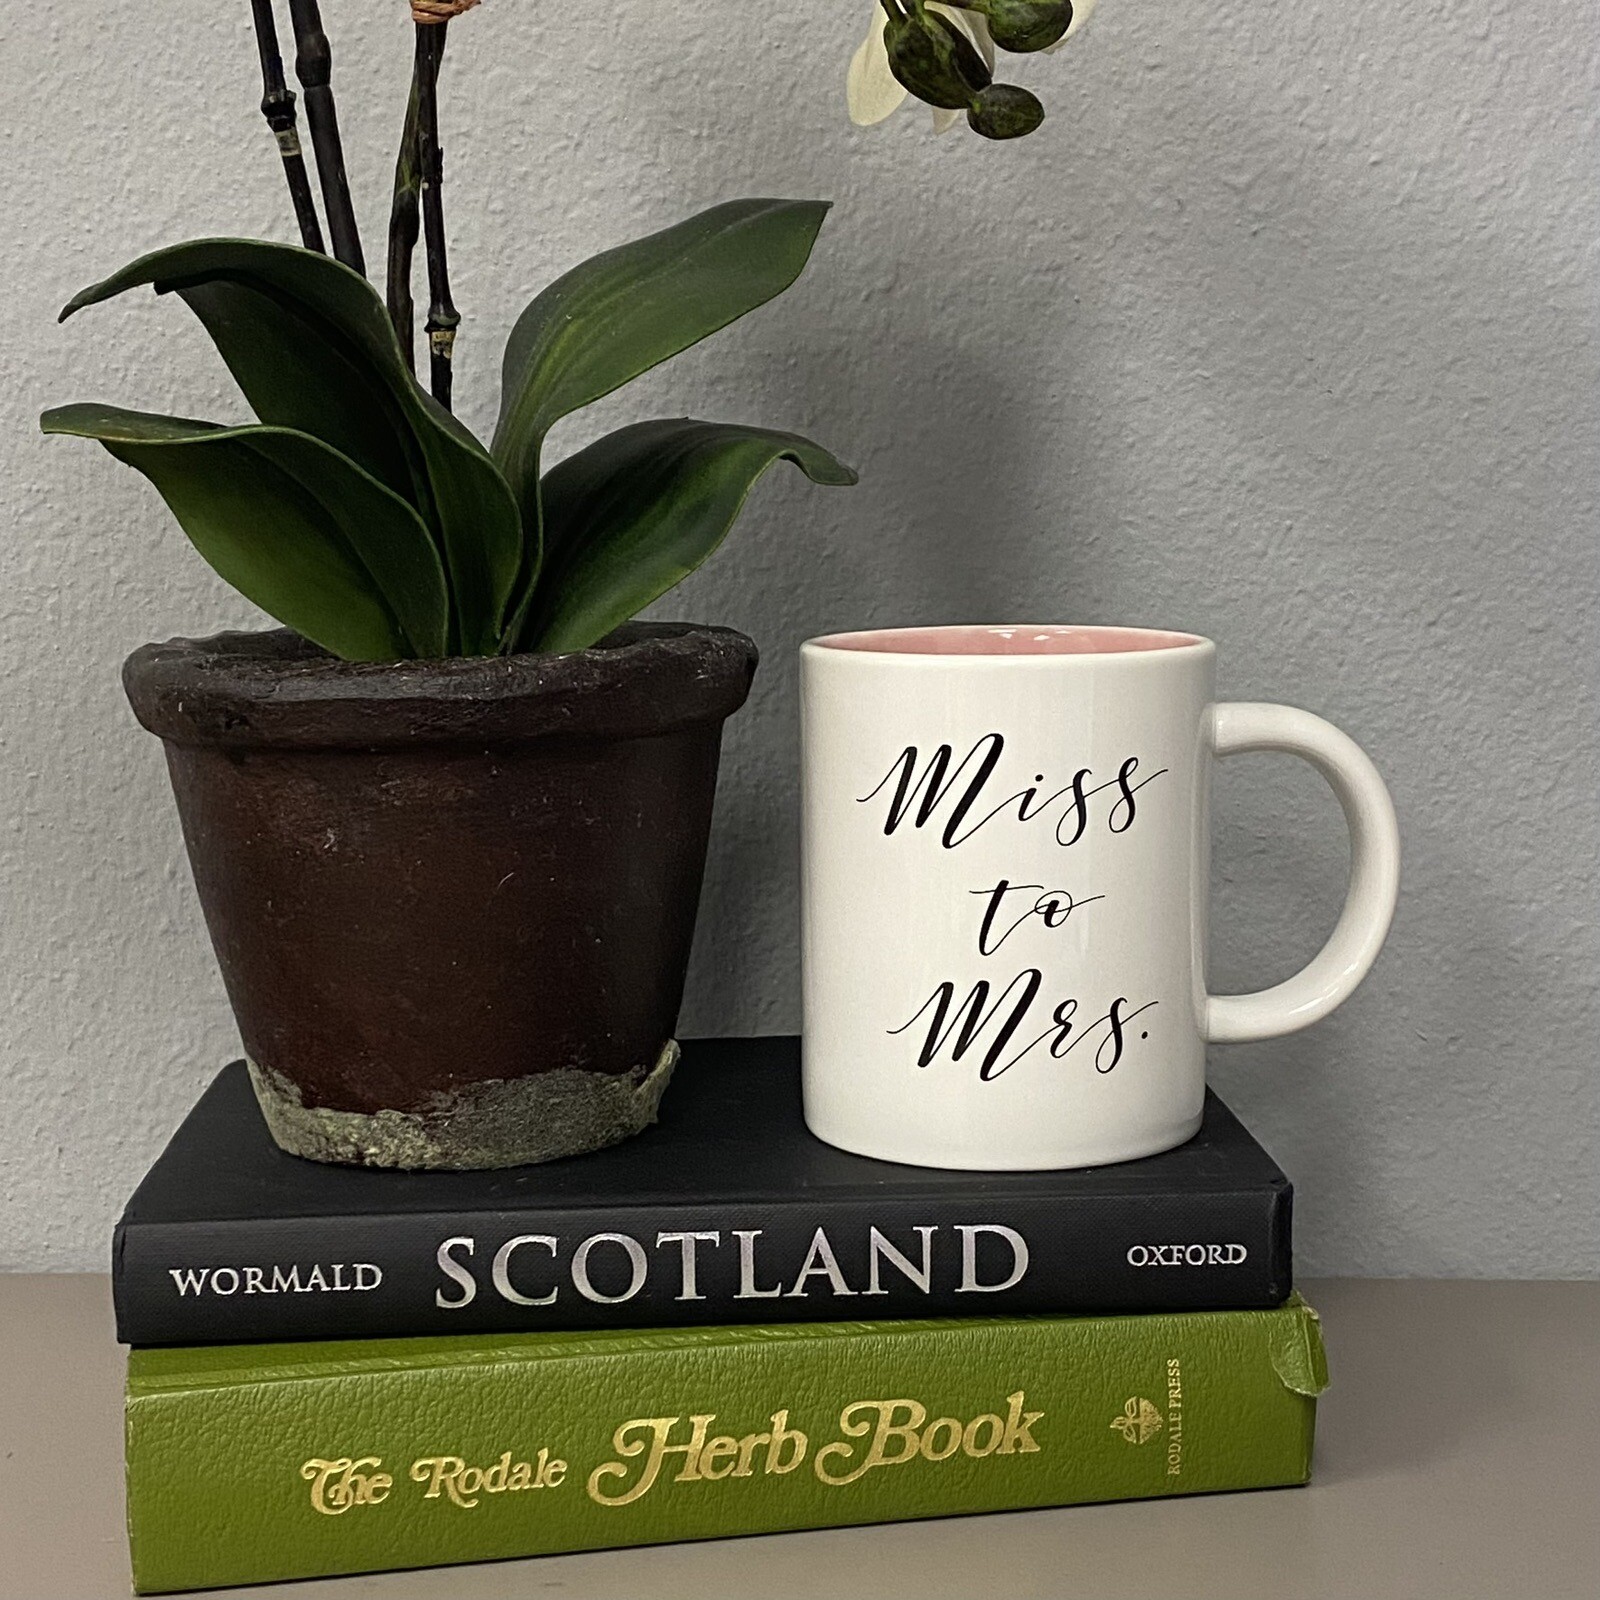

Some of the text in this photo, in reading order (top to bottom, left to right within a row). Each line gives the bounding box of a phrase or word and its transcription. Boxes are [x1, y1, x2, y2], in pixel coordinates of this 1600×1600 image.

[856, 733, 1169, 849] Miss
[969, 879, 1106, 956] to
[886, 968, 1159, 1081] Mrs.
[169, 1263, 383, 1297] WORMALD
[436, 1224, 1029, 1309] SCOTLAND
[1126, 1243, 1248, 1267] OXFORD
[301, 1390, 1045, 1515] The Rodale Herb Book
[1167, 1358, 1182, 1475] RODALE PRESS
